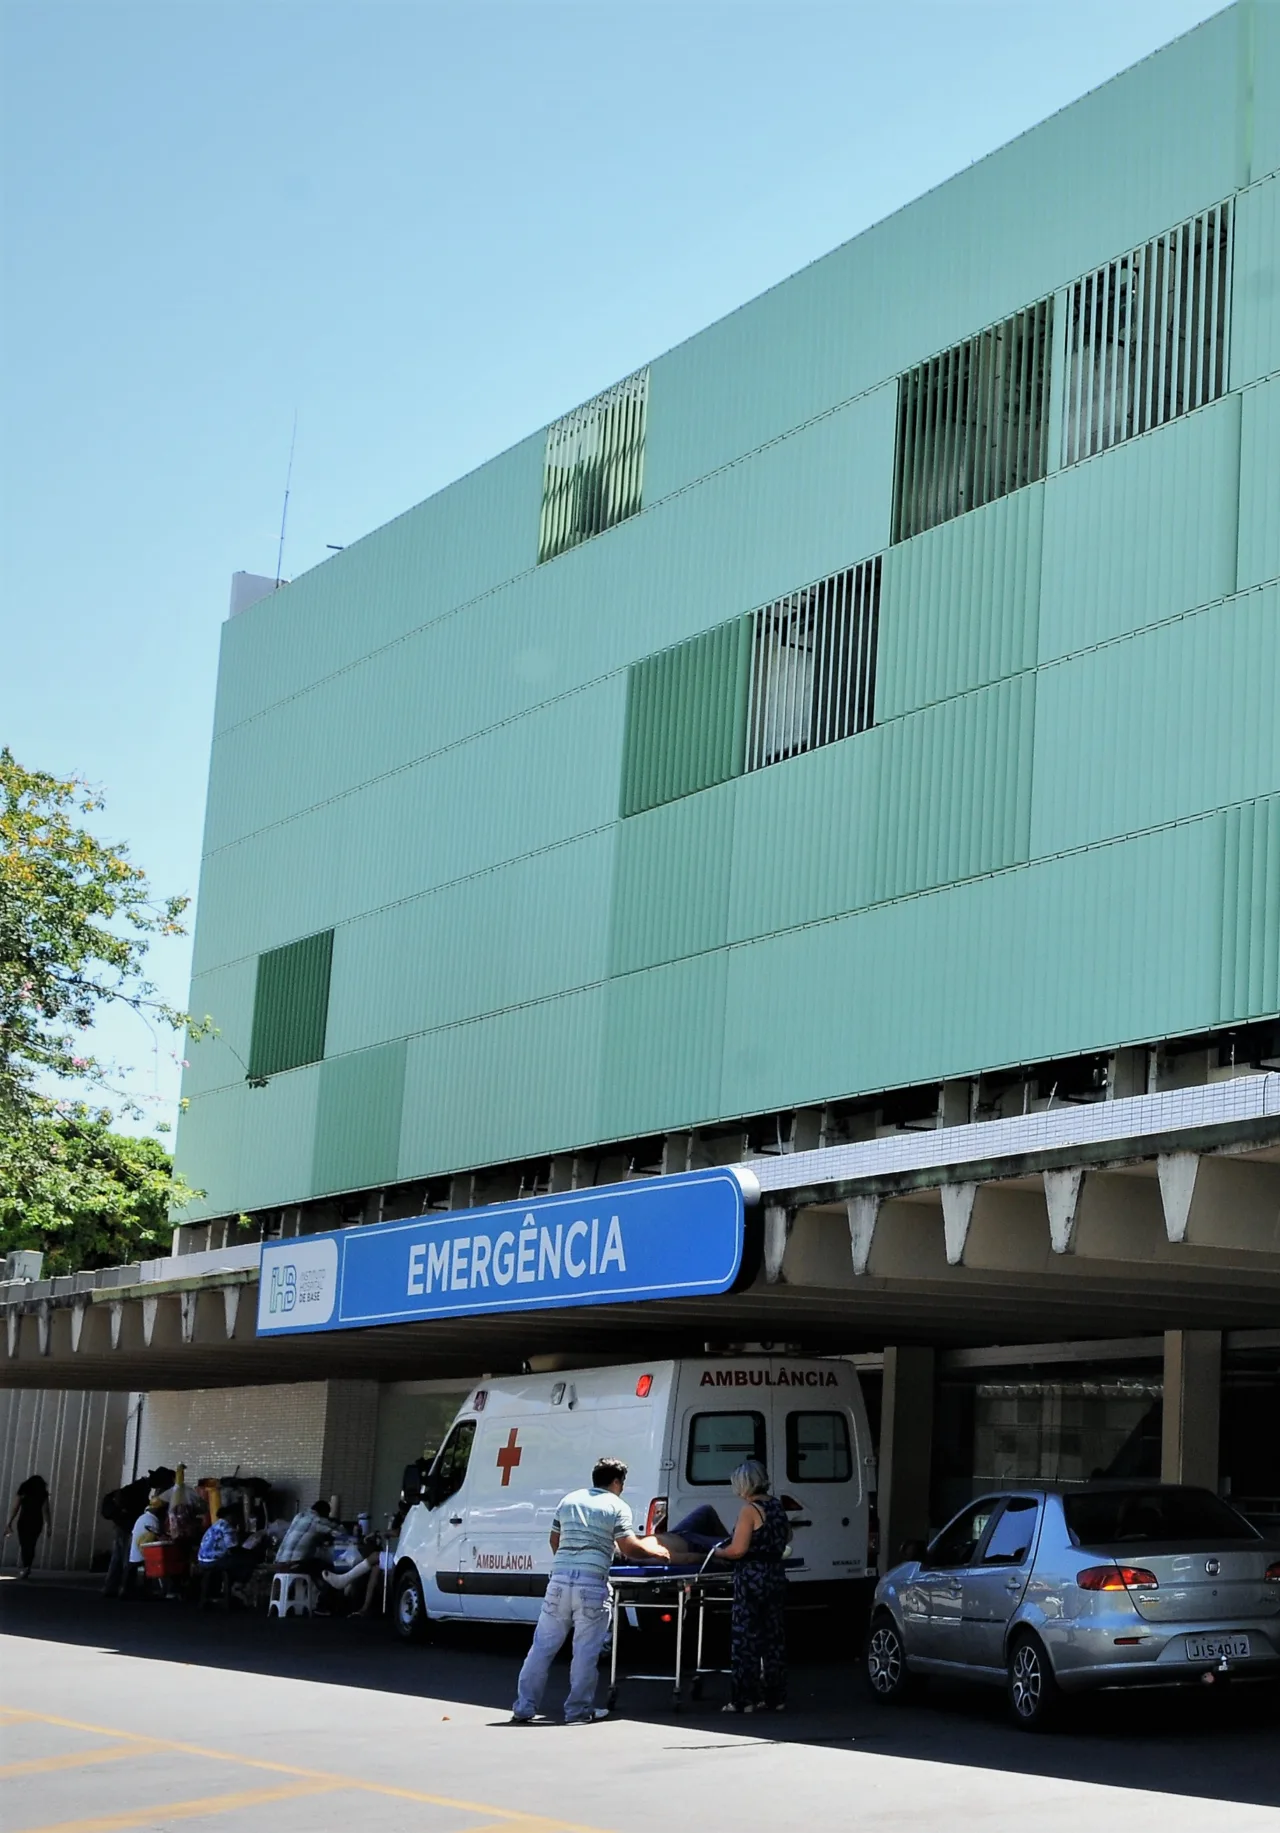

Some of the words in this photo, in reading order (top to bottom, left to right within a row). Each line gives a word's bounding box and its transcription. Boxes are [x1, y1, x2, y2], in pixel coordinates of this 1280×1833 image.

[407, 1213, 627, 1296] EMERGÊNCIA
[700, 1367, 839, 1387] AMBULÂNCIA
[476, 1551, 533, 1570] AMBULÂNCIA
